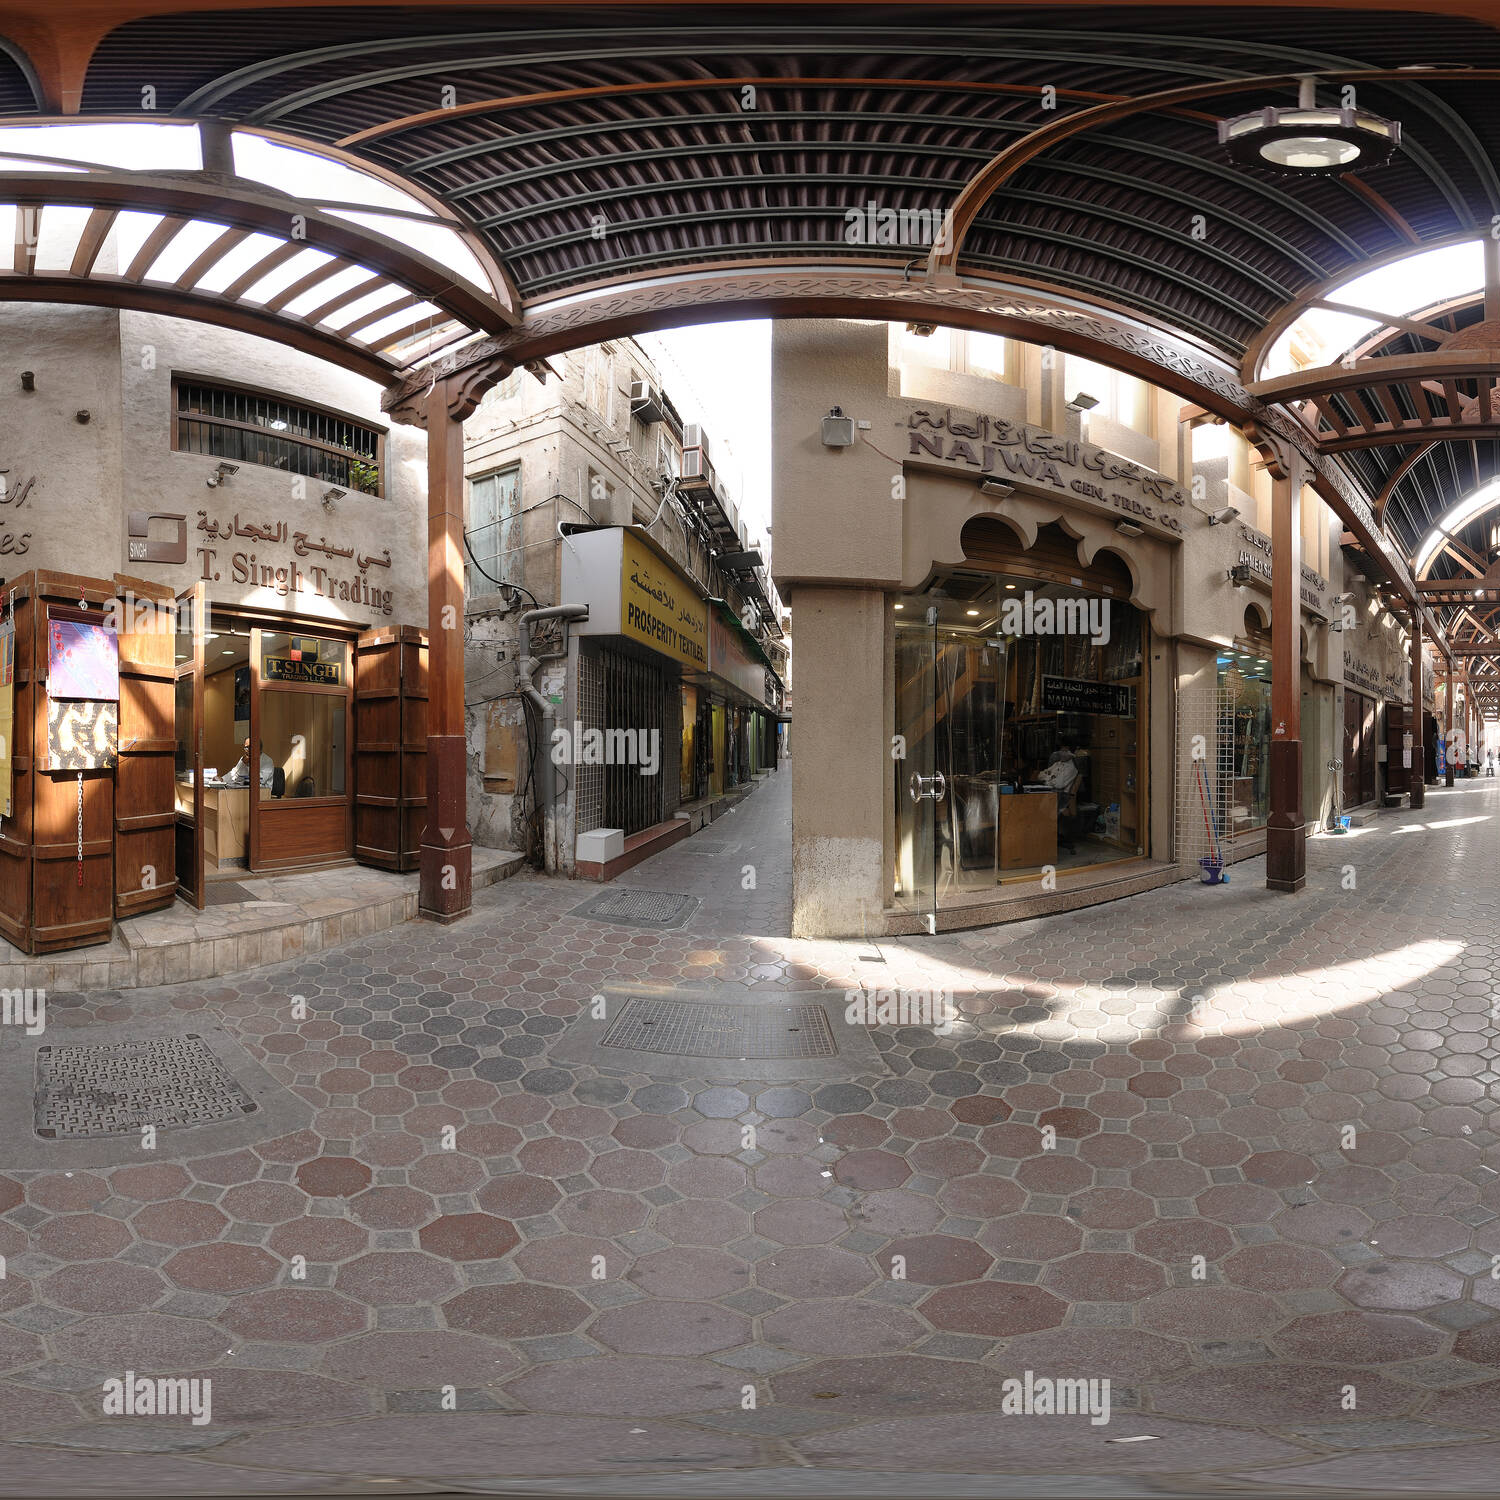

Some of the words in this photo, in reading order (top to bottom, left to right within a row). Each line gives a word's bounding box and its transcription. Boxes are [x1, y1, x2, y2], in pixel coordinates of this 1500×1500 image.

[909, 408, 991, 441] العامة
[909, 432, 1066, 488] NAJWA
[1070, 479, 1106, 503] GEN.
[1111, 493, 1157, 521] TRDG.
[1159, 513, 1184, 534] CO.
[196, 510, 288, 543] التجارية
[129, 542, 147, 558] SINGH
[293, 530, 354, 559] سينج
[1239, 550, 1262, 573] AHMED
[197, 547, 220, 581] T.
[232, 551, 304, 596] Singh
[311, 565, 393, 615] Trading
[628, 602, 678, 648] PROSPERITY
[678, 633, 704, 662] TEXTILES
